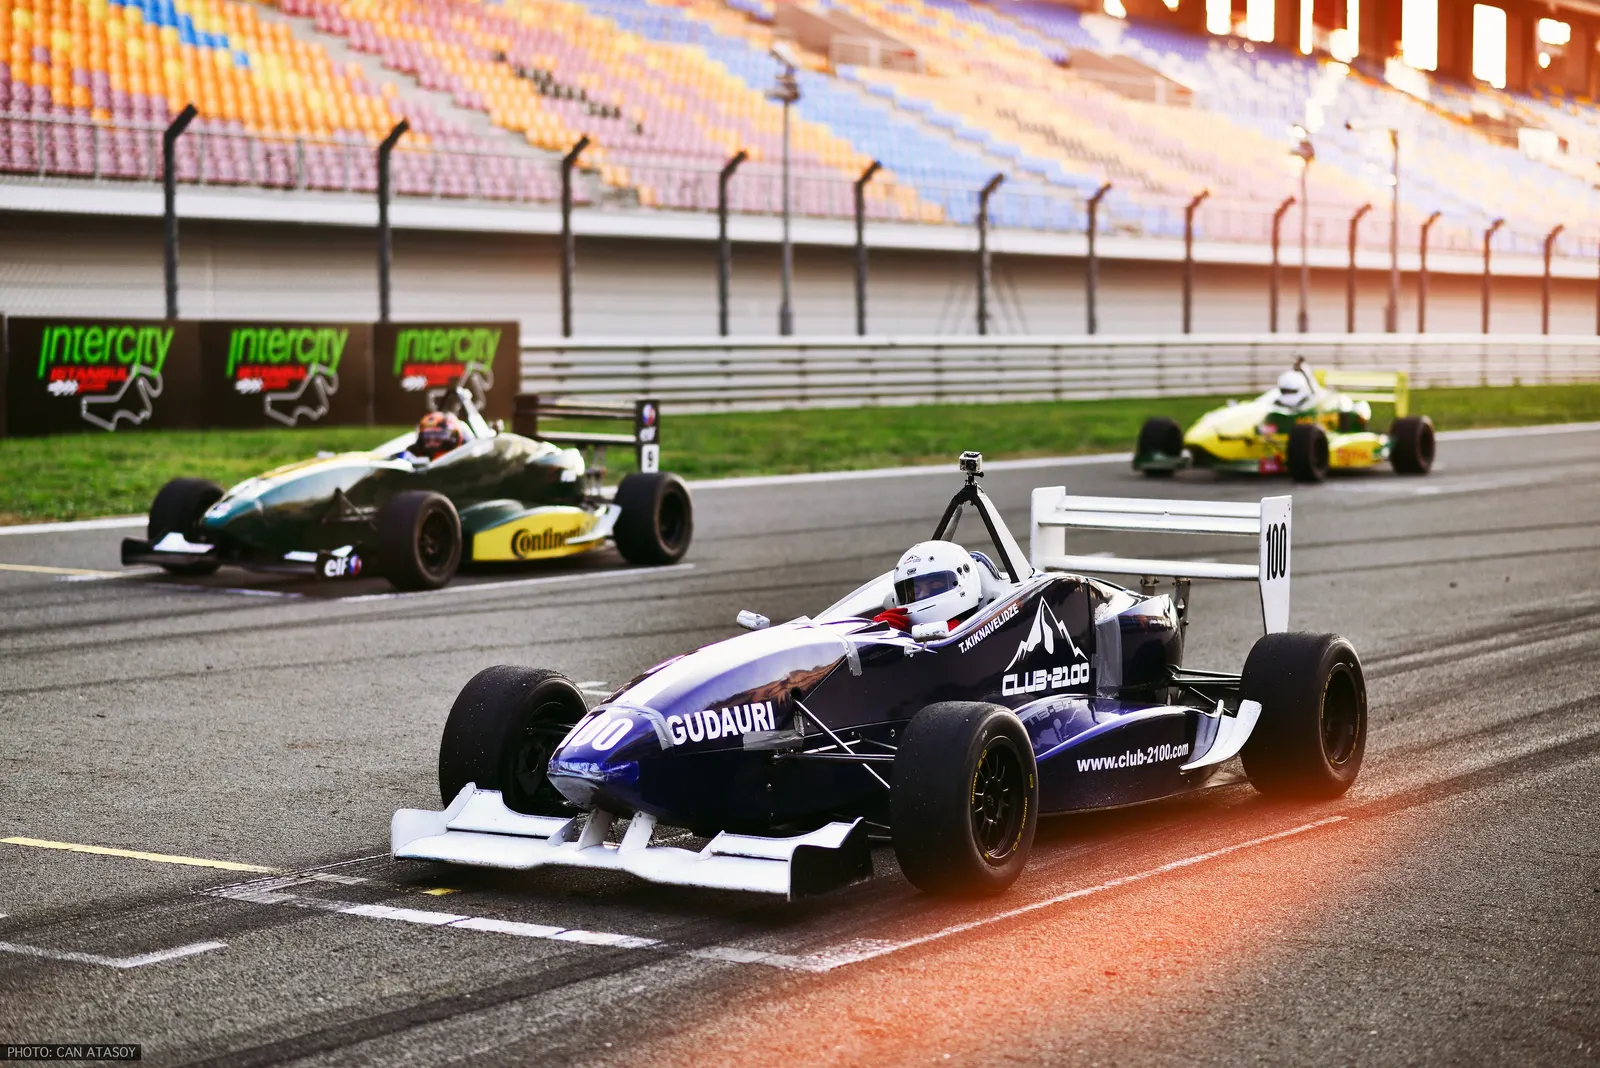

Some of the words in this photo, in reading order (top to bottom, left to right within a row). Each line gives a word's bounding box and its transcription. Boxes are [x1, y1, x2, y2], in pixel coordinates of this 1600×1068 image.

[324, 556, 349, 577] elf
[1266, 522, 1287, 581] 100
[958, 603, 1020, 654] T.KIKNAVELIDZE
[1002, 662, 1090, 697] CLUB-2100
[666, 701, 776, 745] GUDAURI
[1076, 743, 1189, 772] www.club-2100.com
